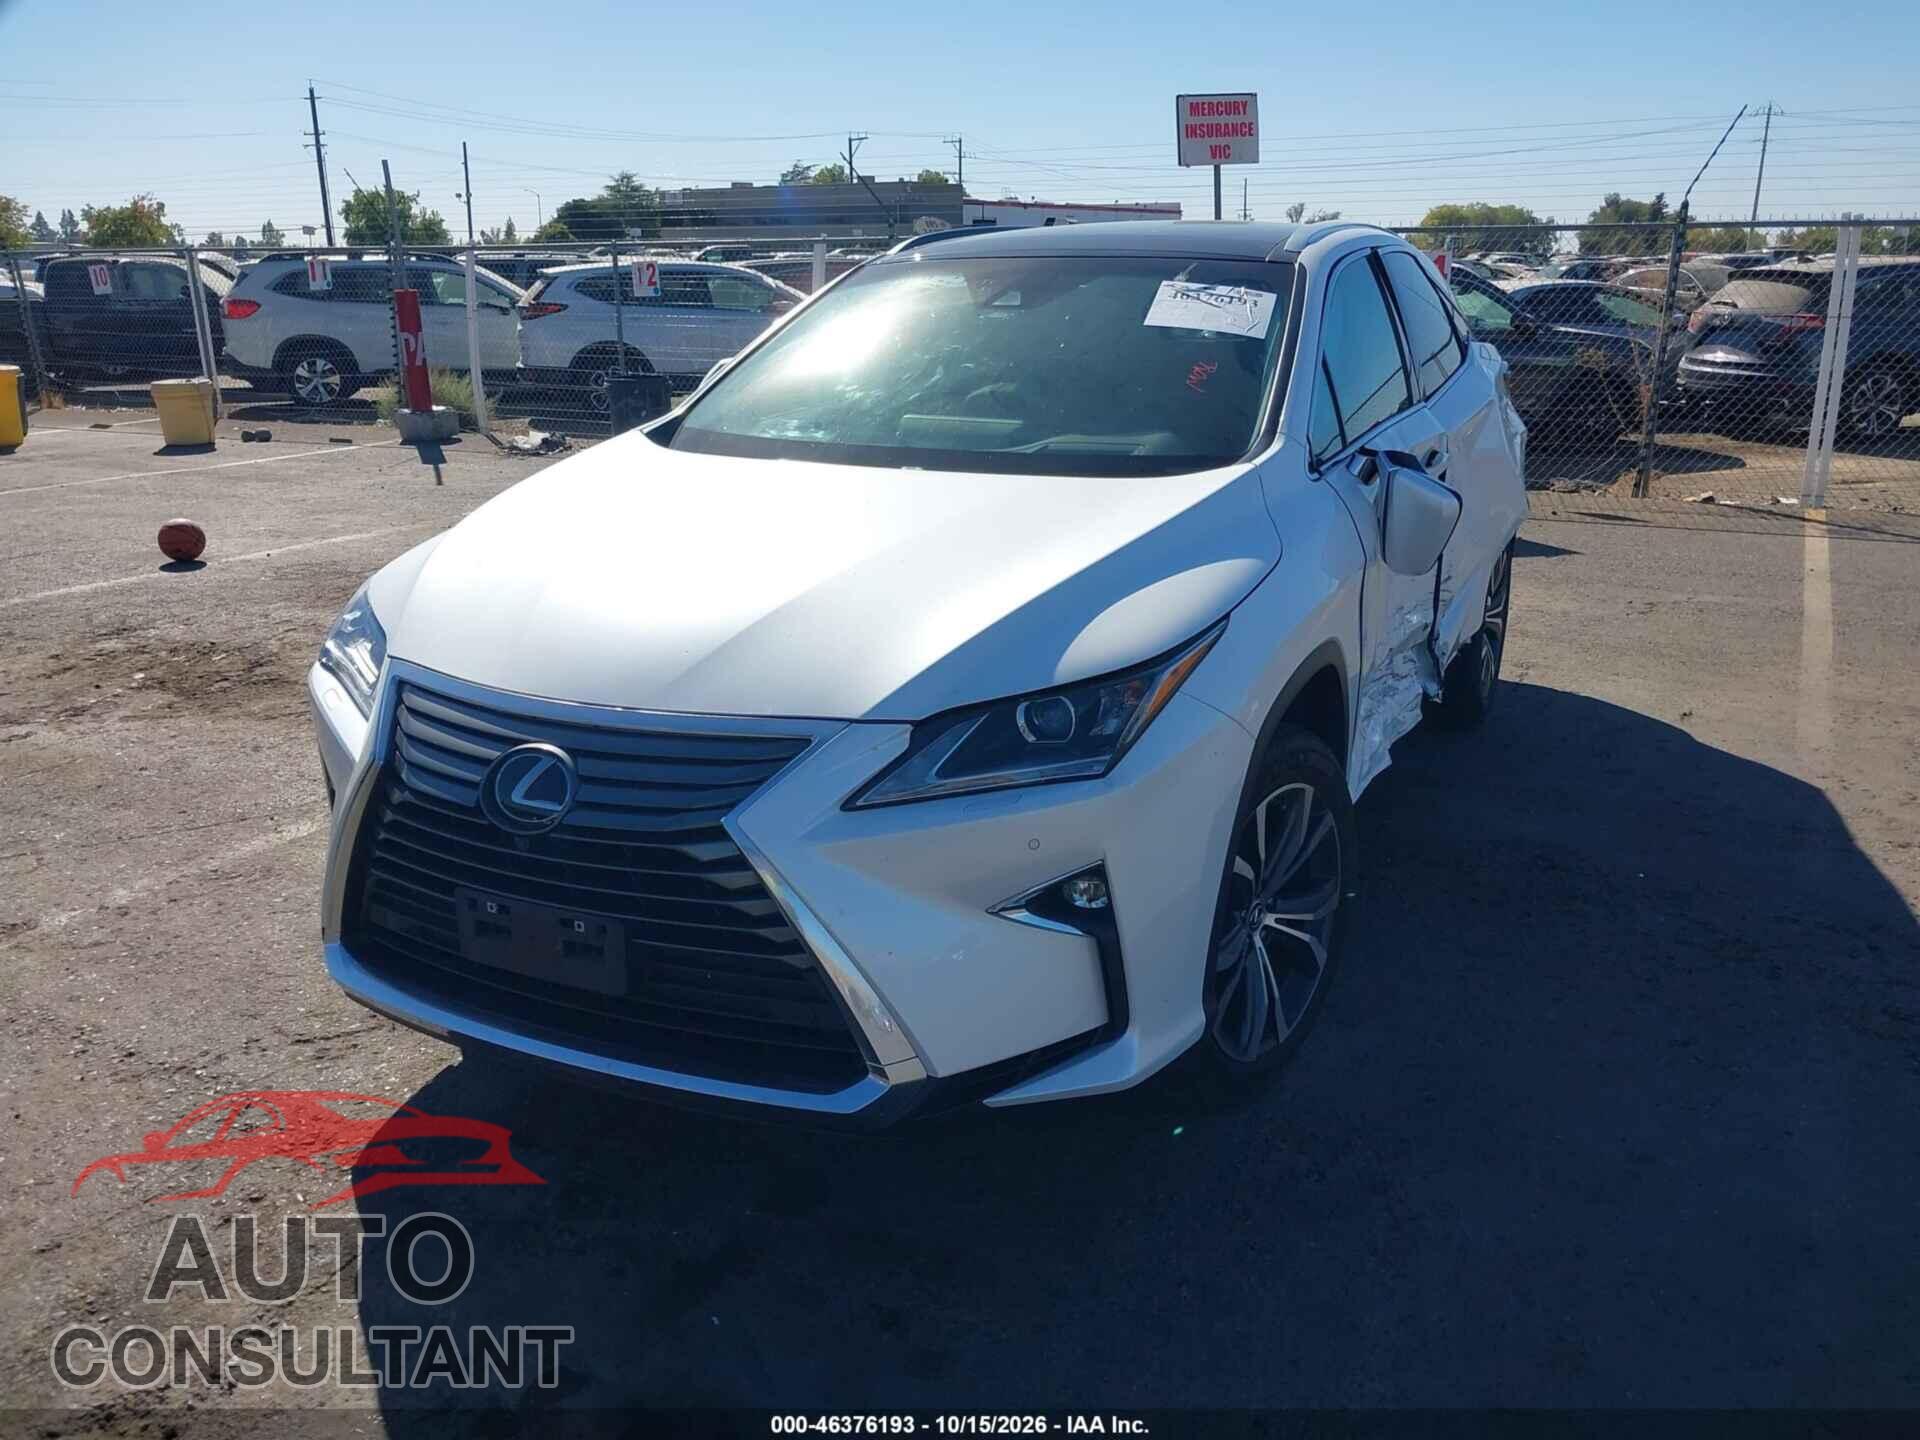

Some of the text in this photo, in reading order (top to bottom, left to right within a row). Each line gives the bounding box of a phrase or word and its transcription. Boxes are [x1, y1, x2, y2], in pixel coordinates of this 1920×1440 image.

[1189, 101, 1248, 117] MERCURY
[1185, 122, 1254, 139] INSURANCE
[1209, 144, 1231, 160] VIC
[93, 266, 108, 287] 10
[637, 263, 657, 287] 12
